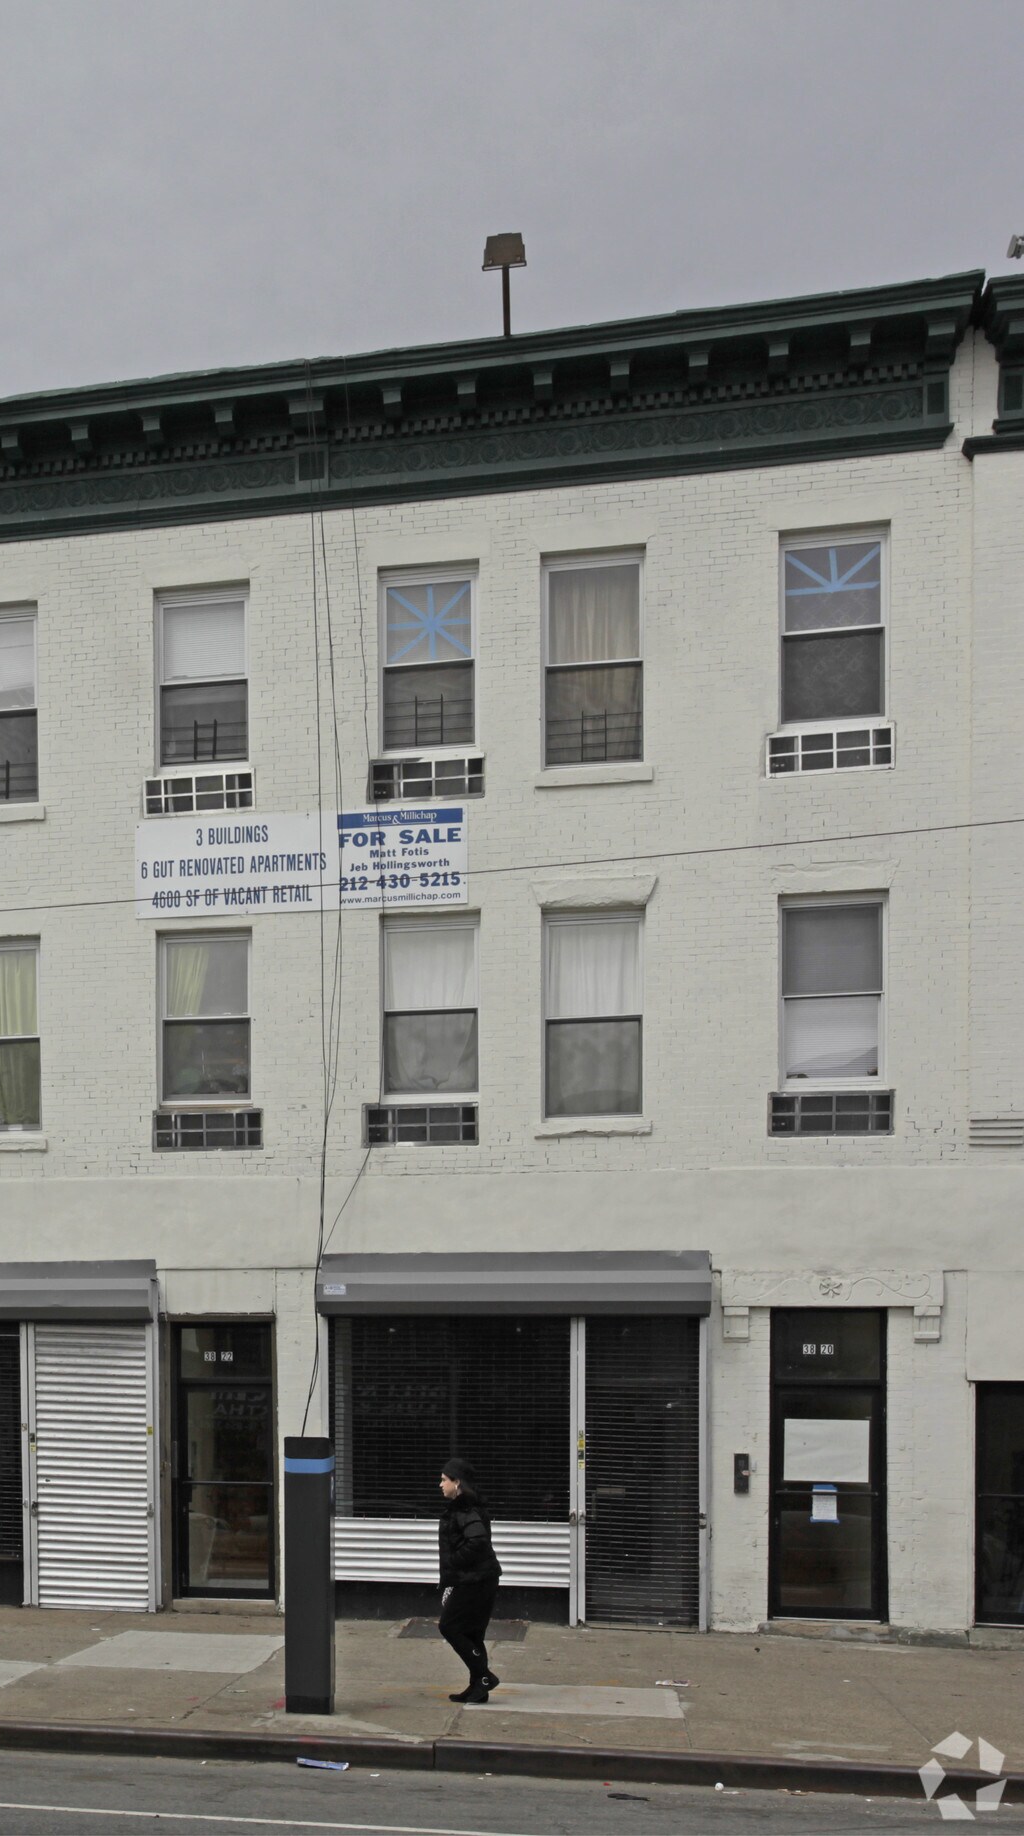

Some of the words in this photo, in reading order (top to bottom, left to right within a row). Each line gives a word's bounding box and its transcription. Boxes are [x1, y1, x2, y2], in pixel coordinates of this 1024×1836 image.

[363, 814, 391, 822] Marcus
[392, 815, 400, 824] &
[400, 810, 436, 822] Millichap
[196, 828, 203, 846] 3
[208, 825, 268, 845] BUILDINGS
[339, 831, 386, 848] FOR
[399, 827, 461, 844] SALE
[370, 849, 396, 858] Matt
[402, 847, 429, 856] Fotis
[141, 862, 148, 879] 6
[153, 860, 174, 878] GUT
[179, 856, 244, 877] RENOVATED
[250, 852, 326, 873] APARTMENTS
[350, 863, 368, 872] Jeb
[373, 858, 450, 870] Hollingsworth
[339, 871, 460, 892] 212-430-5215
[152, 890, 180, 909] 4600
[186, 889, 200, 907] SF
[205, 888, 219, 906] OF
[224, 886, 268, 906] VACANT
[273, 884, 312, 903] RETAIL
[340, 892, 460, 904] www.marcusmillichap.com
[803, 1344, 816, 1354] 38
[821, 1344, 834, 1354] 20
[205, 1352, 216, 1361] 38
[221, 1352, 233, 1361] 22
